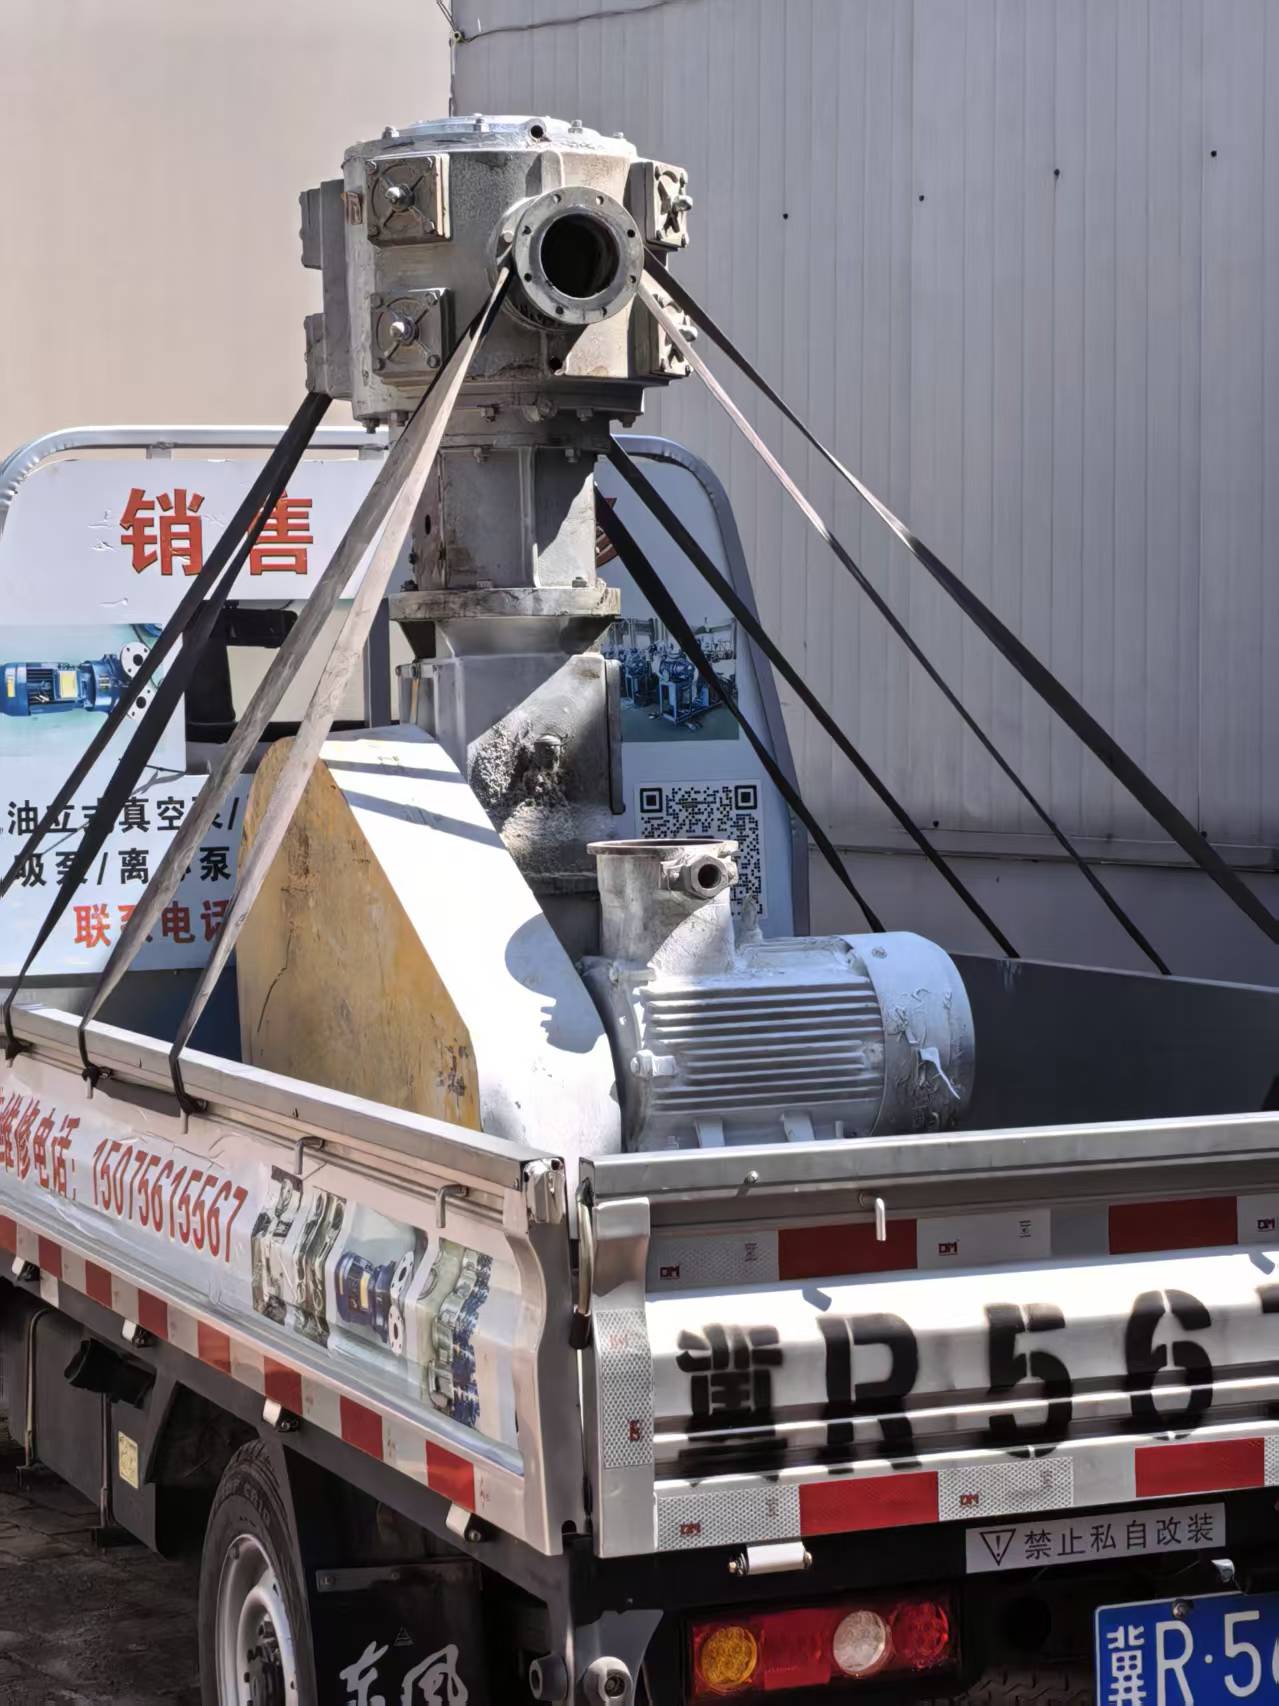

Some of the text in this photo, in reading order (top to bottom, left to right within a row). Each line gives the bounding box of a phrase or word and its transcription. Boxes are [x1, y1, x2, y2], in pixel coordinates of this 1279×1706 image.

[120, 487, 313, 576] 销售
[92, 1137, 249, 1264] 15075615567
[1023, 1512, 1215, 1560] 禁止私自改装
[1106, 1610, 1279, 1706] 冀R·5
